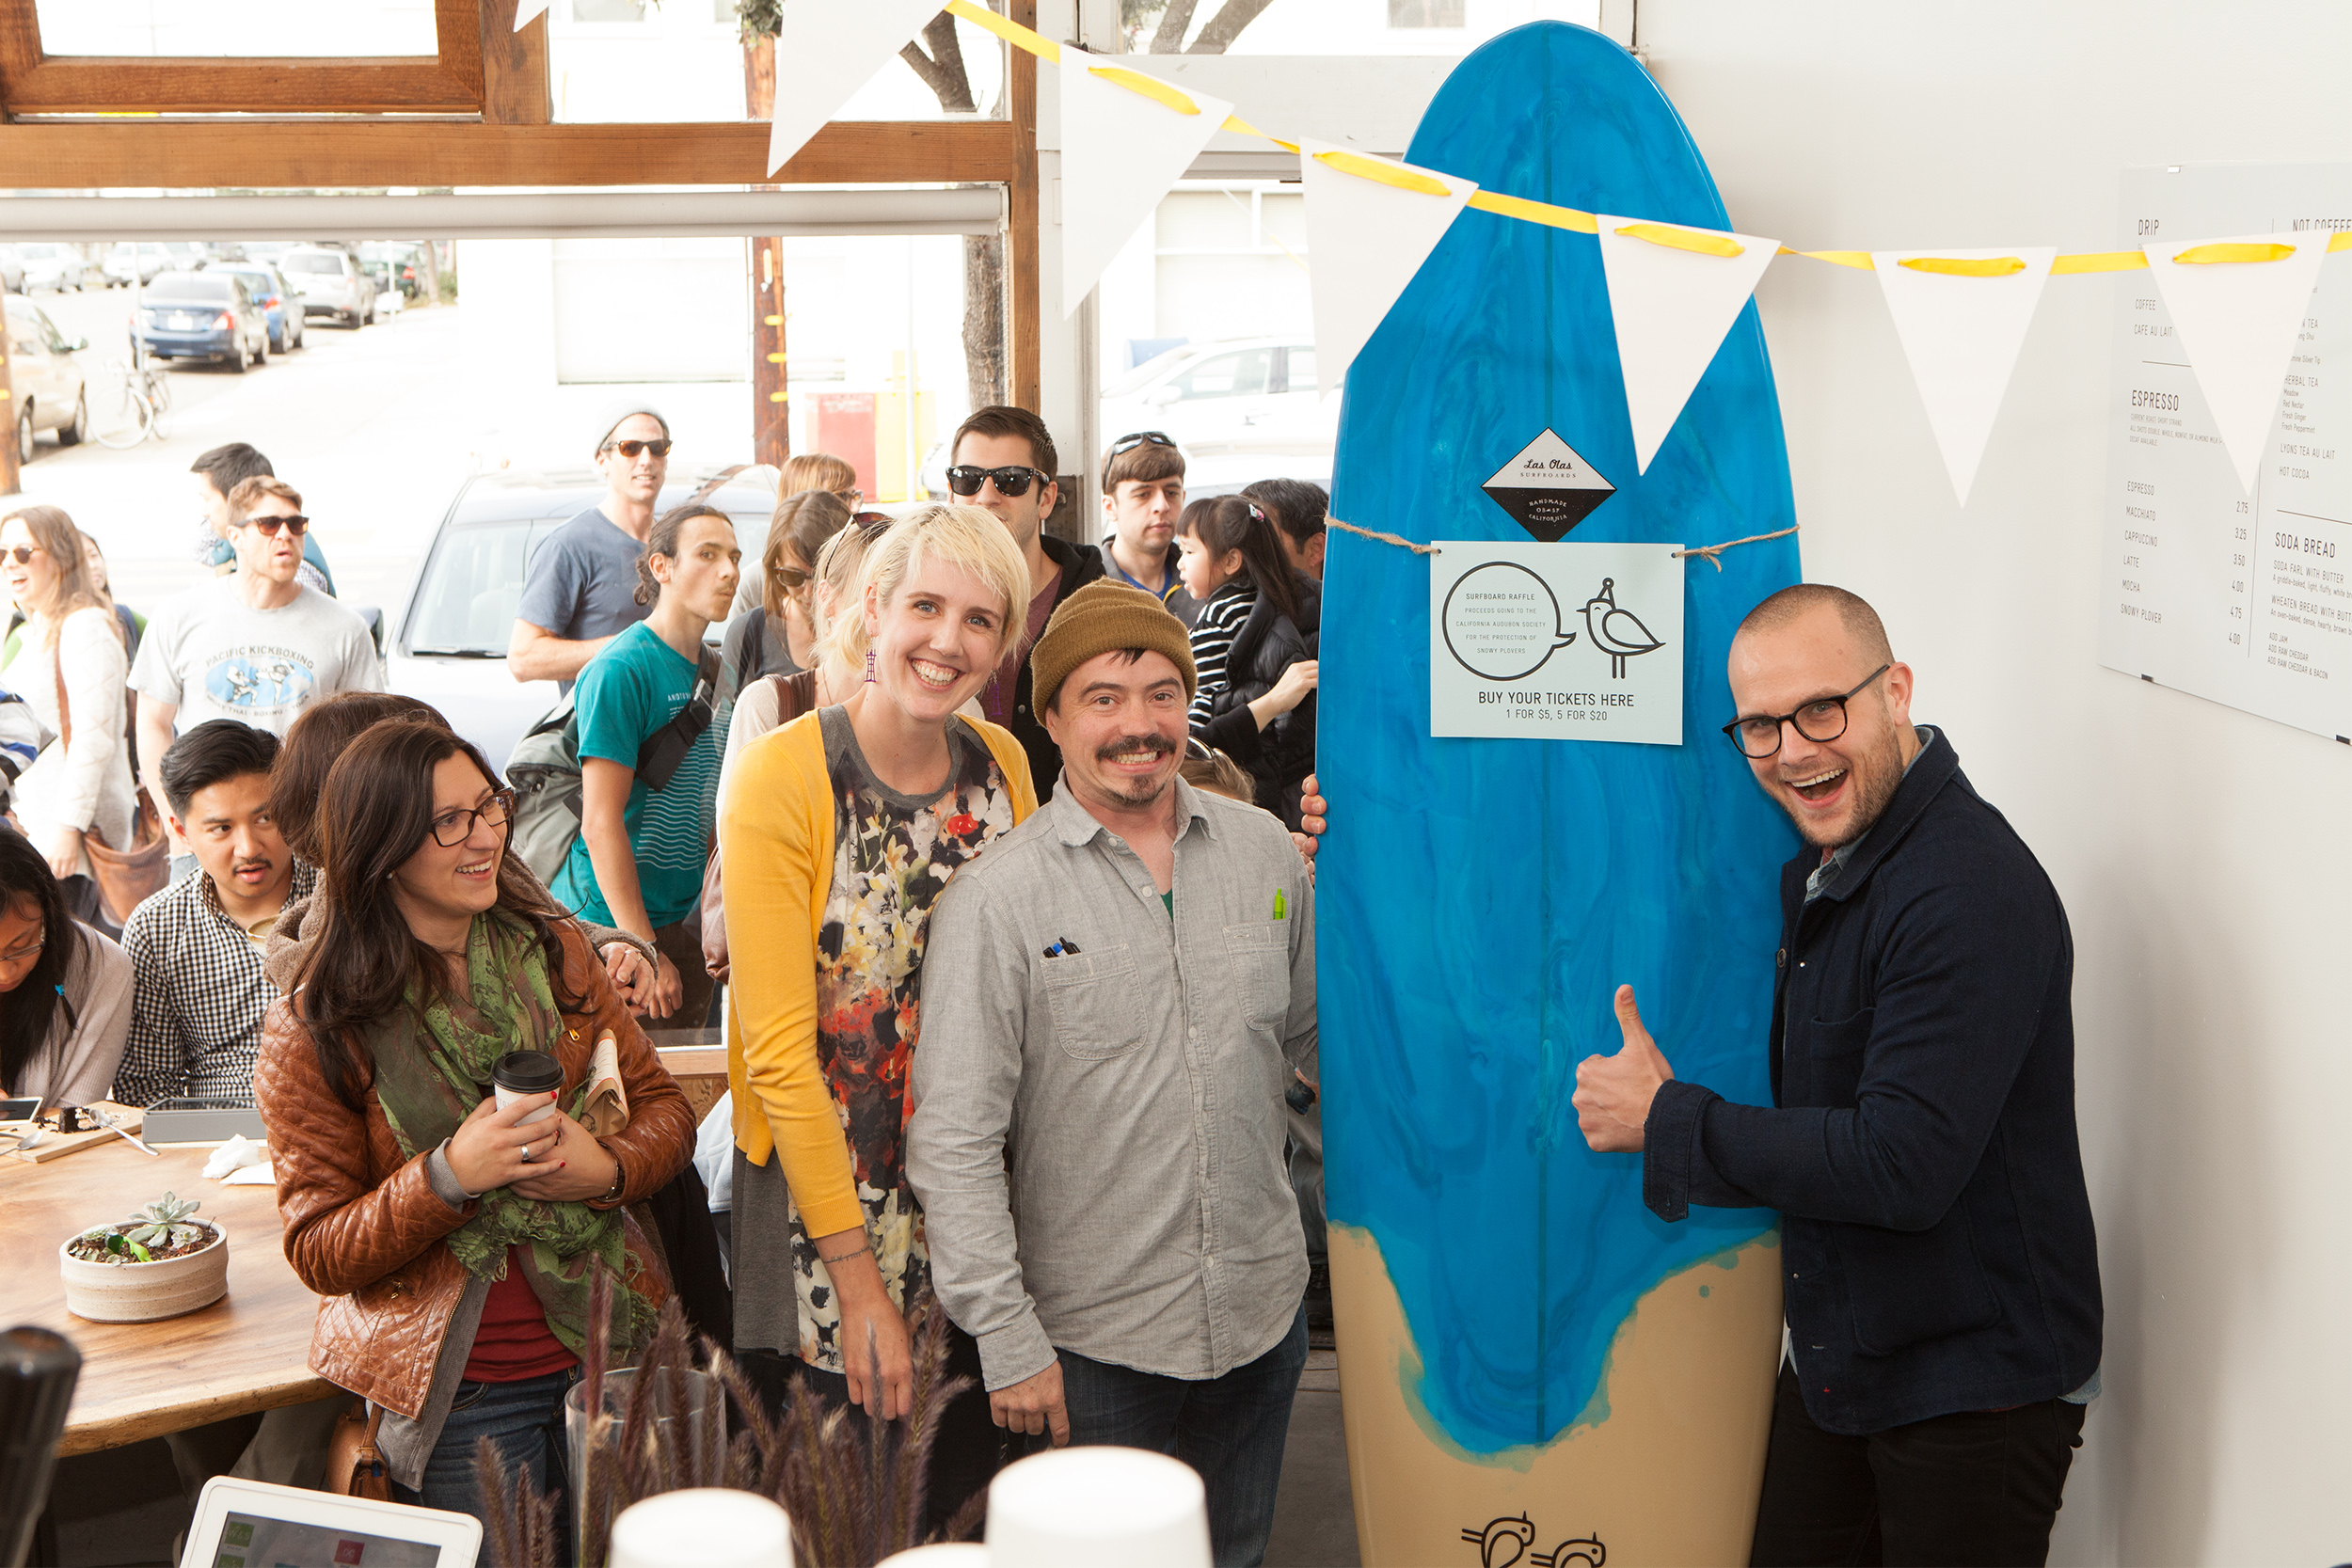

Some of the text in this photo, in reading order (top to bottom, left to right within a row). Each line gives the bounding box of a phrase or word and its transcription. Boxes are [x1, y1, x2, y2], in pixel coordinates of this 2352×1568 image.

[2137, 219, 2160, 236] DRIP
[2293, 218, 2311, 231] NOT
[2136, 299, 2156, 310] COFFEE
[2308, 318, 2319, 329] TEA
[2134, 324, 2172, 338] CAFE AU LAIT
[2284, 374, 2319, 388] HERBAL TEA
[2132, 389, 2179, 411] ESPRESSO
[2282, 422, 2293, 431] Fresh
[2280, 443, 2335, 460] LYONS TEA AU LAIT
[1524, 459, 1572, 469] Las Olas
[2279, 467, 2310, 480] HOT COCOA
[2127, 481, 2155, 496] ESPRESSO
[1529, 499, 1567, 507] HANDMADE
[2236, 500, 2249, 515] 2.75
[1529, 514, 1567, 523] CALIFORNIA
[2126, 506, 2156, 522] MACCHIATO
[2124, 531, 2158, 547] CAPPUCCINO
[2235, 527, 2248, 541] 3.25
[2275, 532, 2336, 558] SODA BREAD
[2122, 555, 2140, 568] LATTE
[2233, 553, 2246, 567] 3.50
[2273, 560, 2344, 584] SODA FARL WITH BUTTER
[2122, 579, 2141, 594] MOCHA
[2232, 579, 2244, 594] 4.00
[2121, 603, 2162, 625] SNOWY PLOVER
[2230, 606, 2243, 620] 4.75
[2271, 594, 2352, 623] WHEATEN BREAD WITH BUTT
[2229, 632, 2241, 645] 4.00
[2269, 632, 2288, 643] ADD JAM
[206, 645, 314, 670] PACIFIC KICKBOXING
[2268, 644, 2309, 661] ADD RAW CHEDDAR
[2267, 657, 2277, 665] ADD
[2278, 658, 2287, 668] RAW
[2288, 661, 2309, 673] CHEDDAR
[2313, 668, 2329, 680] BACON
[1479, 691, 1634, 706] BUY YOUR TICKETS HERE
[229, 706, 247, 716] THAI
[1506, 709, 1608, 721] 1 FOR $5, 5 FOR $20
